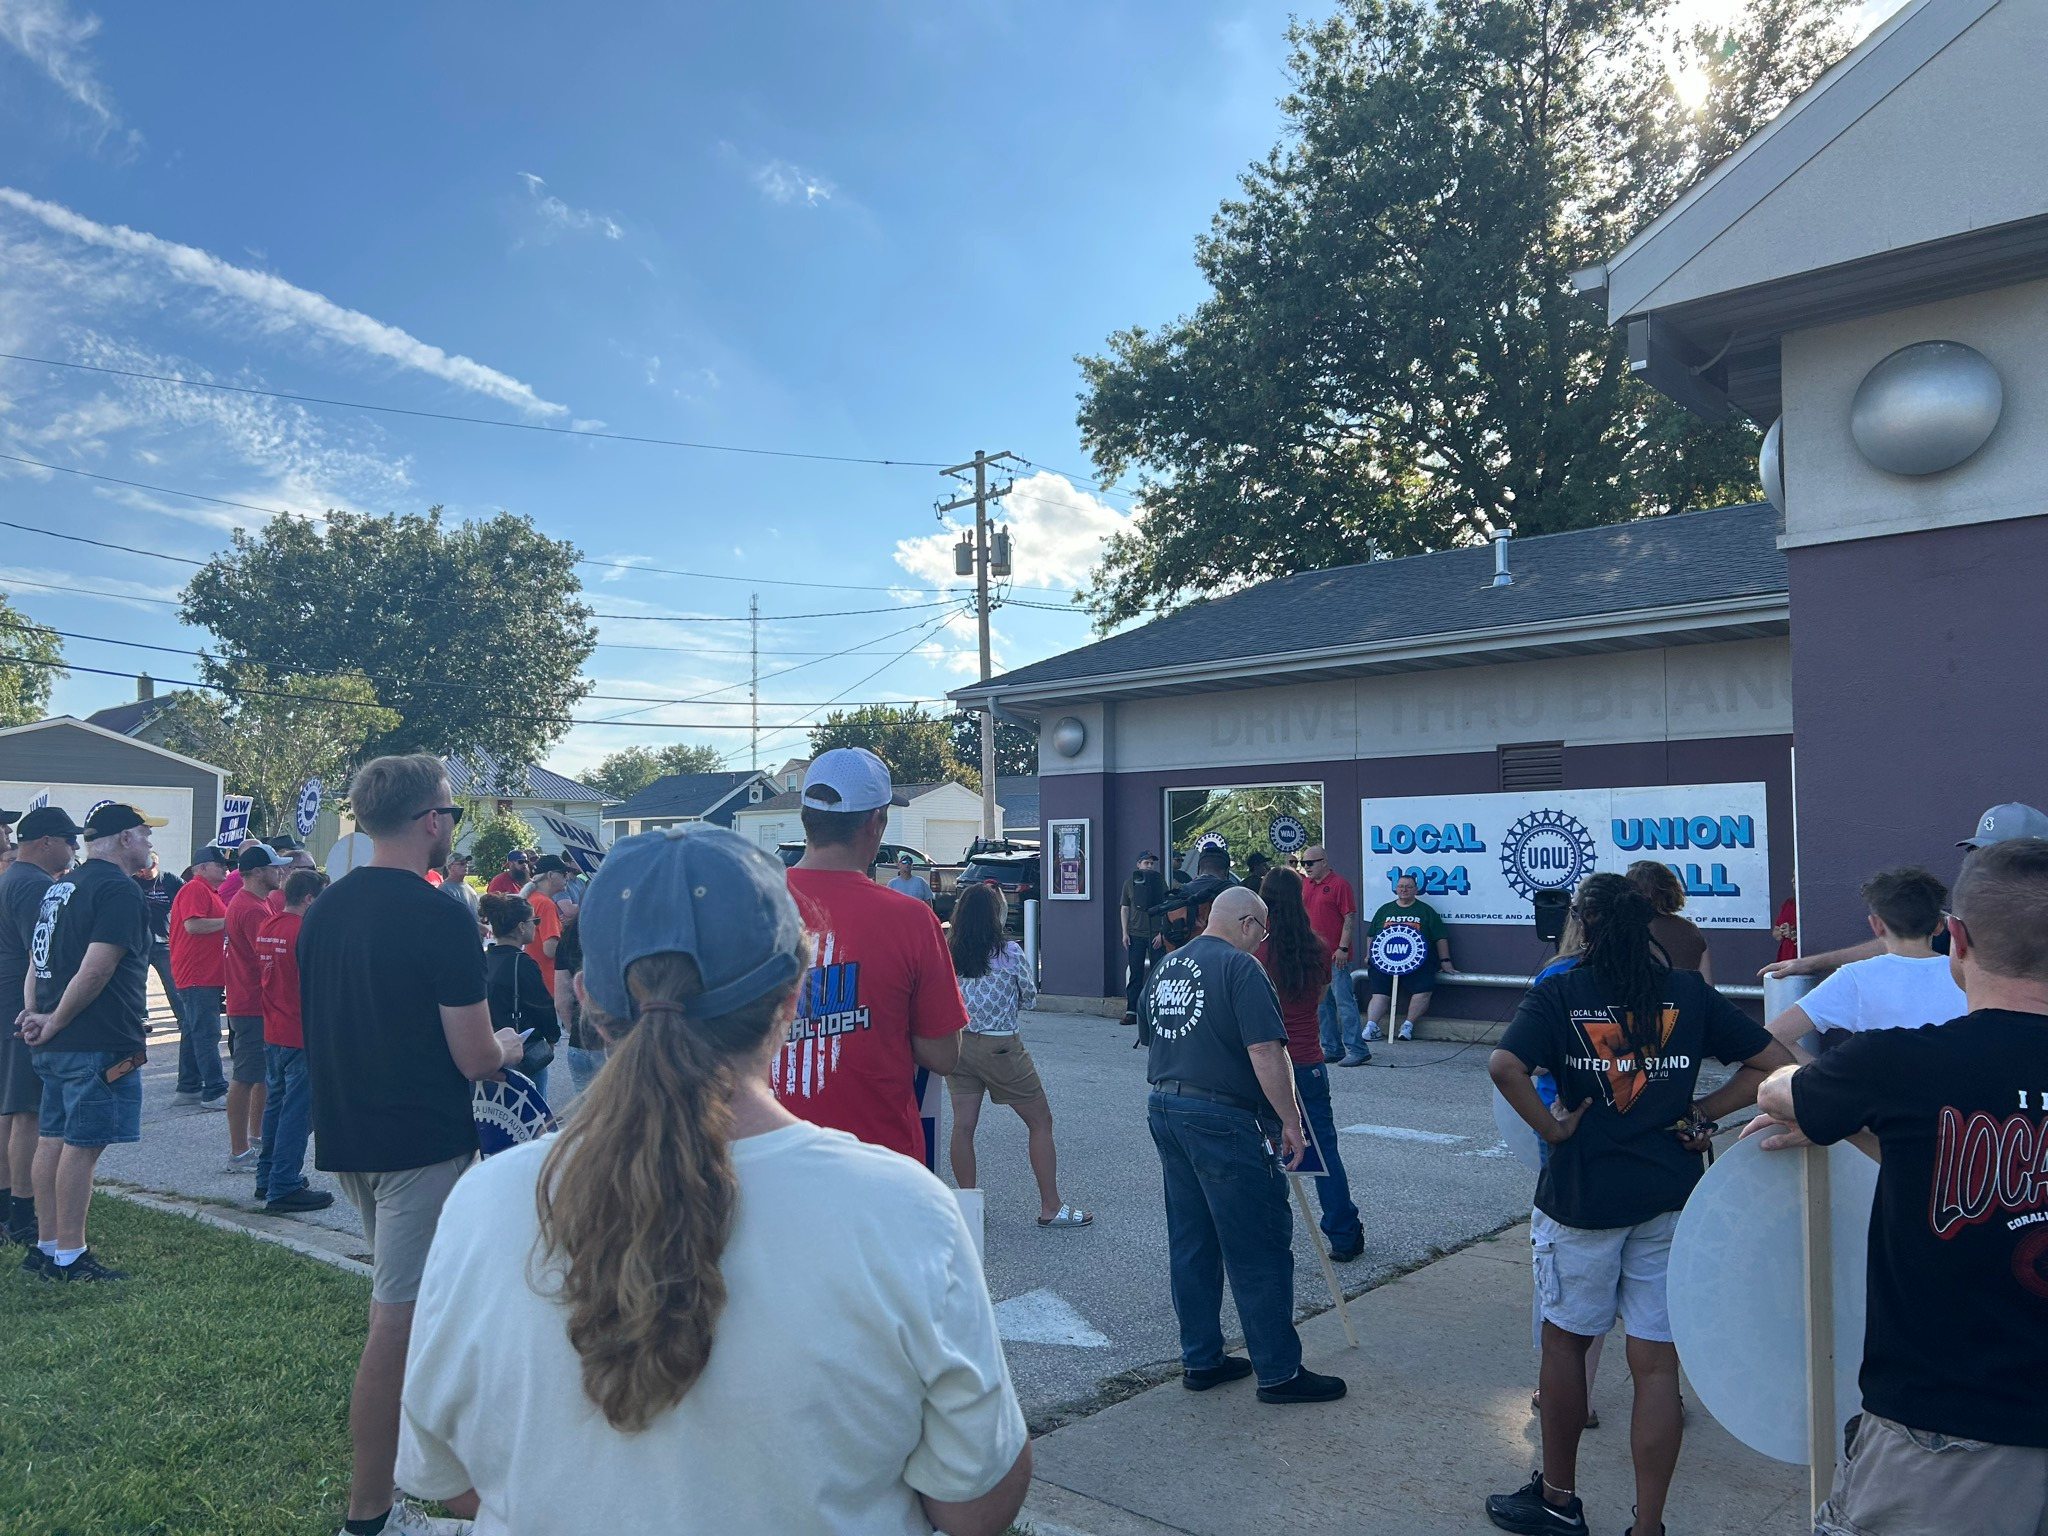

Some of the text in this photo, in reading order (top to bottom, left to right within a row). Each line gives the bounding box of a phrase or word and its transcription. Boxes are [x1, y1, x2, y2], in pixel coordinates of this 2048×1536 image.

[1211, 697, 1362, 748] DRIVE
[1387, 671, 1544, 735] THRU
[224, 799, 250, 813] UAW
[229, 817, 240, 829] ON
[541, 815, 601, 851] UAW
[1612, 815, 1755, 851] UNION
[218, 827, 245, 844] STRIKE
[1371, 823, 1486, 854] LOCAL
[1528, 846, 1569, 870] UAW
[1386, 865, 1471, 896] 1024
[1628, 863, 1741, 897] ALL
[1385, 915, 1421, 924] PASTOR
[1386, 943, 1409, 955] UAW
[821, 1007, 869, 1036] 1024
[1180, 989, 1205, 1036] STRONG
[1570, 1009, 1608, 1017] LOCAL 166
[1565, 1054, 1611, 1072] UNITED
[1645, 1055, 1690, 1071] STAND
[2018, 1090, 2028, 1109] I
[482, 1106, 509, 1121] UNITED
